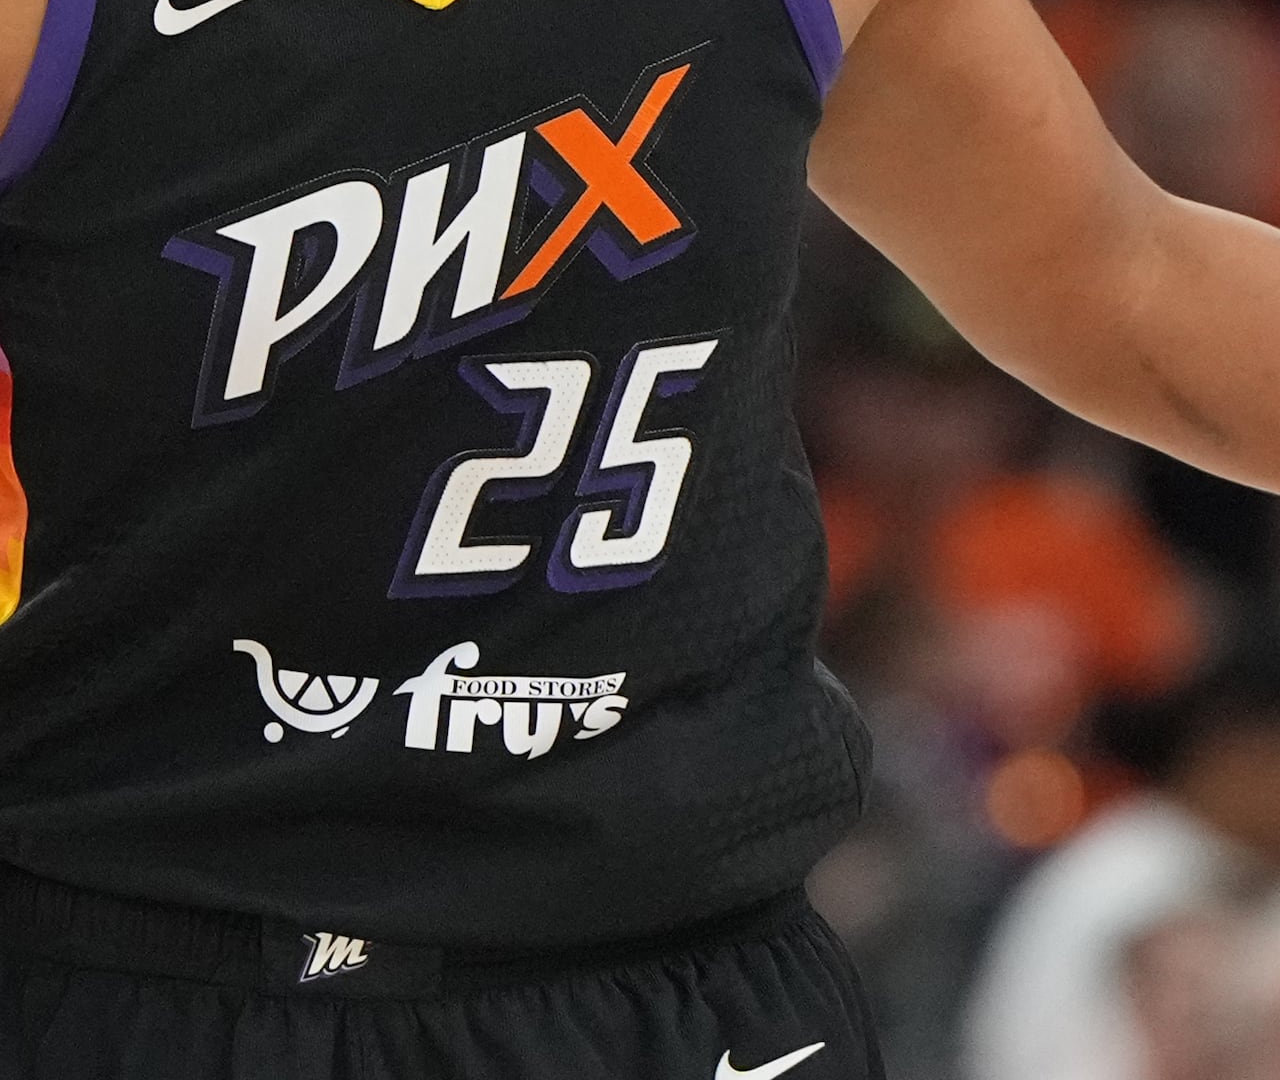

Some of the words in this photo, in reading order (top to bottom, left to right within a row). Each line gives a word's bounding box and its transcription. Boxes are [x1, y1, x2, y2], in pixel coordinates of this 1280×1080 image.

[216, 63, 691, 401] PHX
[414, 339, 720, 576] 25
[452, 678, 517, 696] FOOD
[528, 677, 617, 698] STORES
